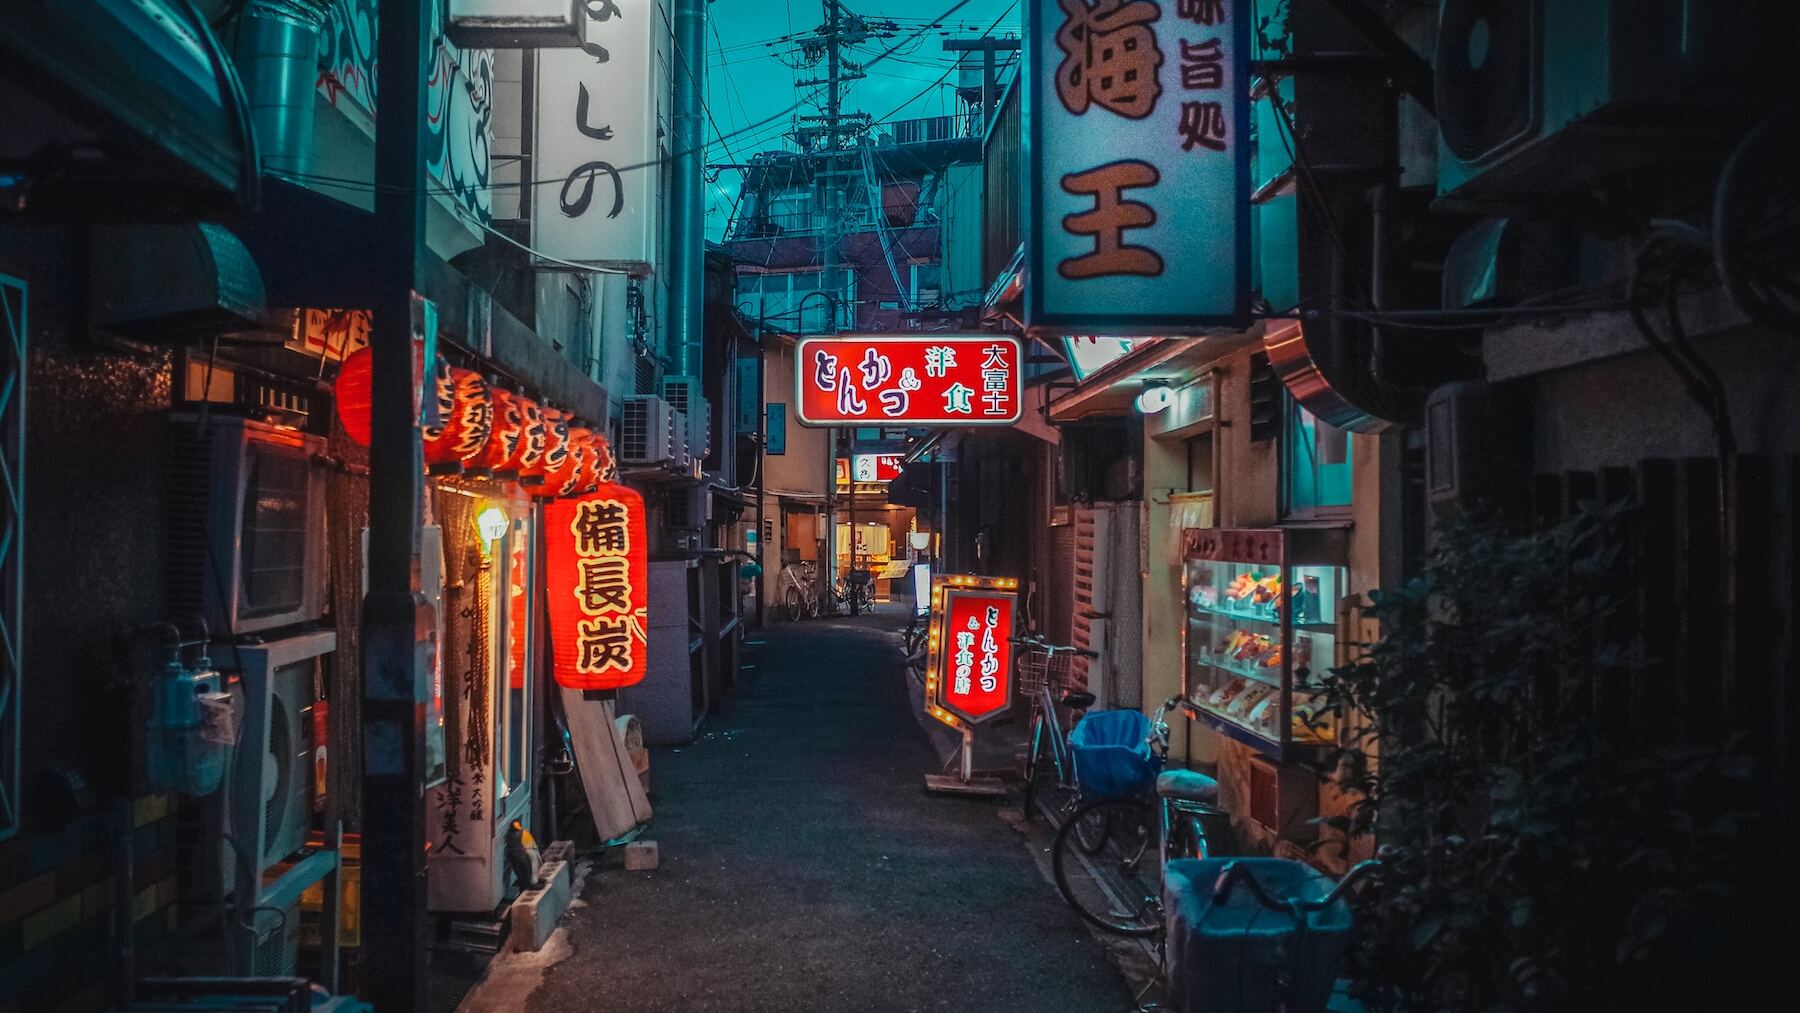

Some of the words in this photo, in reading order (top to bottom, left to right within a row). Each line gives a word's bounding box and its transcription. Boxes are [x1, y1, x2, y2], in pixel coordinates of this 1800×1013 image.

[1055, 0, 1164, 280] 海王
[814, 347, 909, 416] とんかつ
[924, 345, 975, 414] 洋食
[980, 344, 1009, 415] 大富士
[570, 499, 633, 675] 備長炭
[980, 605, 999, 692] とんかつ
